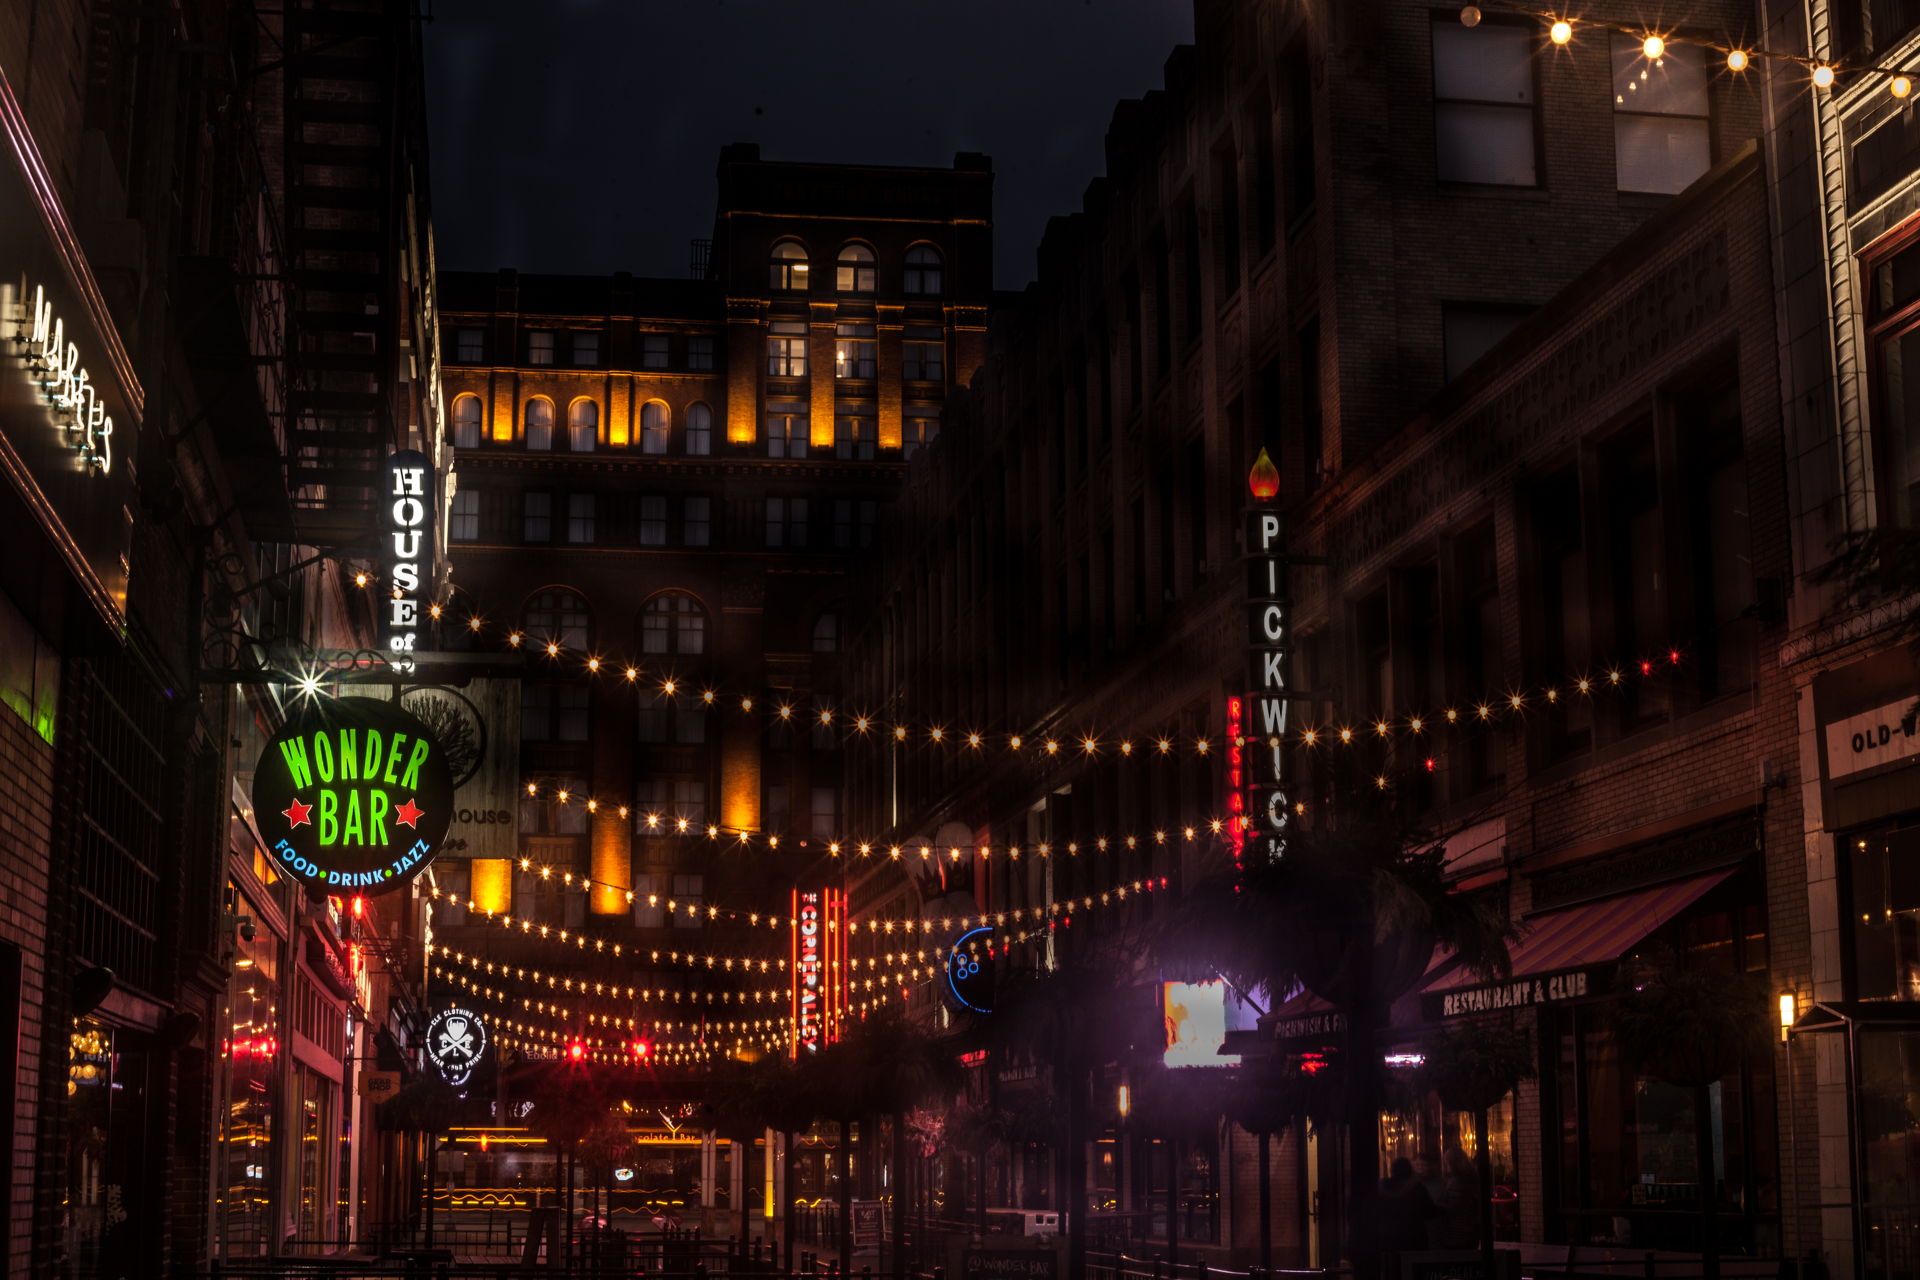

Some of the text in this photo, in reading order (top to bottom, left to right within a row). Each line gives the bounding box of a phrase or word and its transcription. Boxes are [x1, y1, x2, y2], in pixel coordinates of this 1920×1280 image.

[390, 468, 424, 627] HOUSE
[390, 632, 416, 653] of
[279, 728, 431, 791] WONDER
[319, 789, 390, 846] BAR
[274, 839, 430, 886] FOOD DRINK JAZZ
[801, 905, 817, 986] CORNER
[1443, 972, 1588, 1016] RESTAURANT & CLUB
